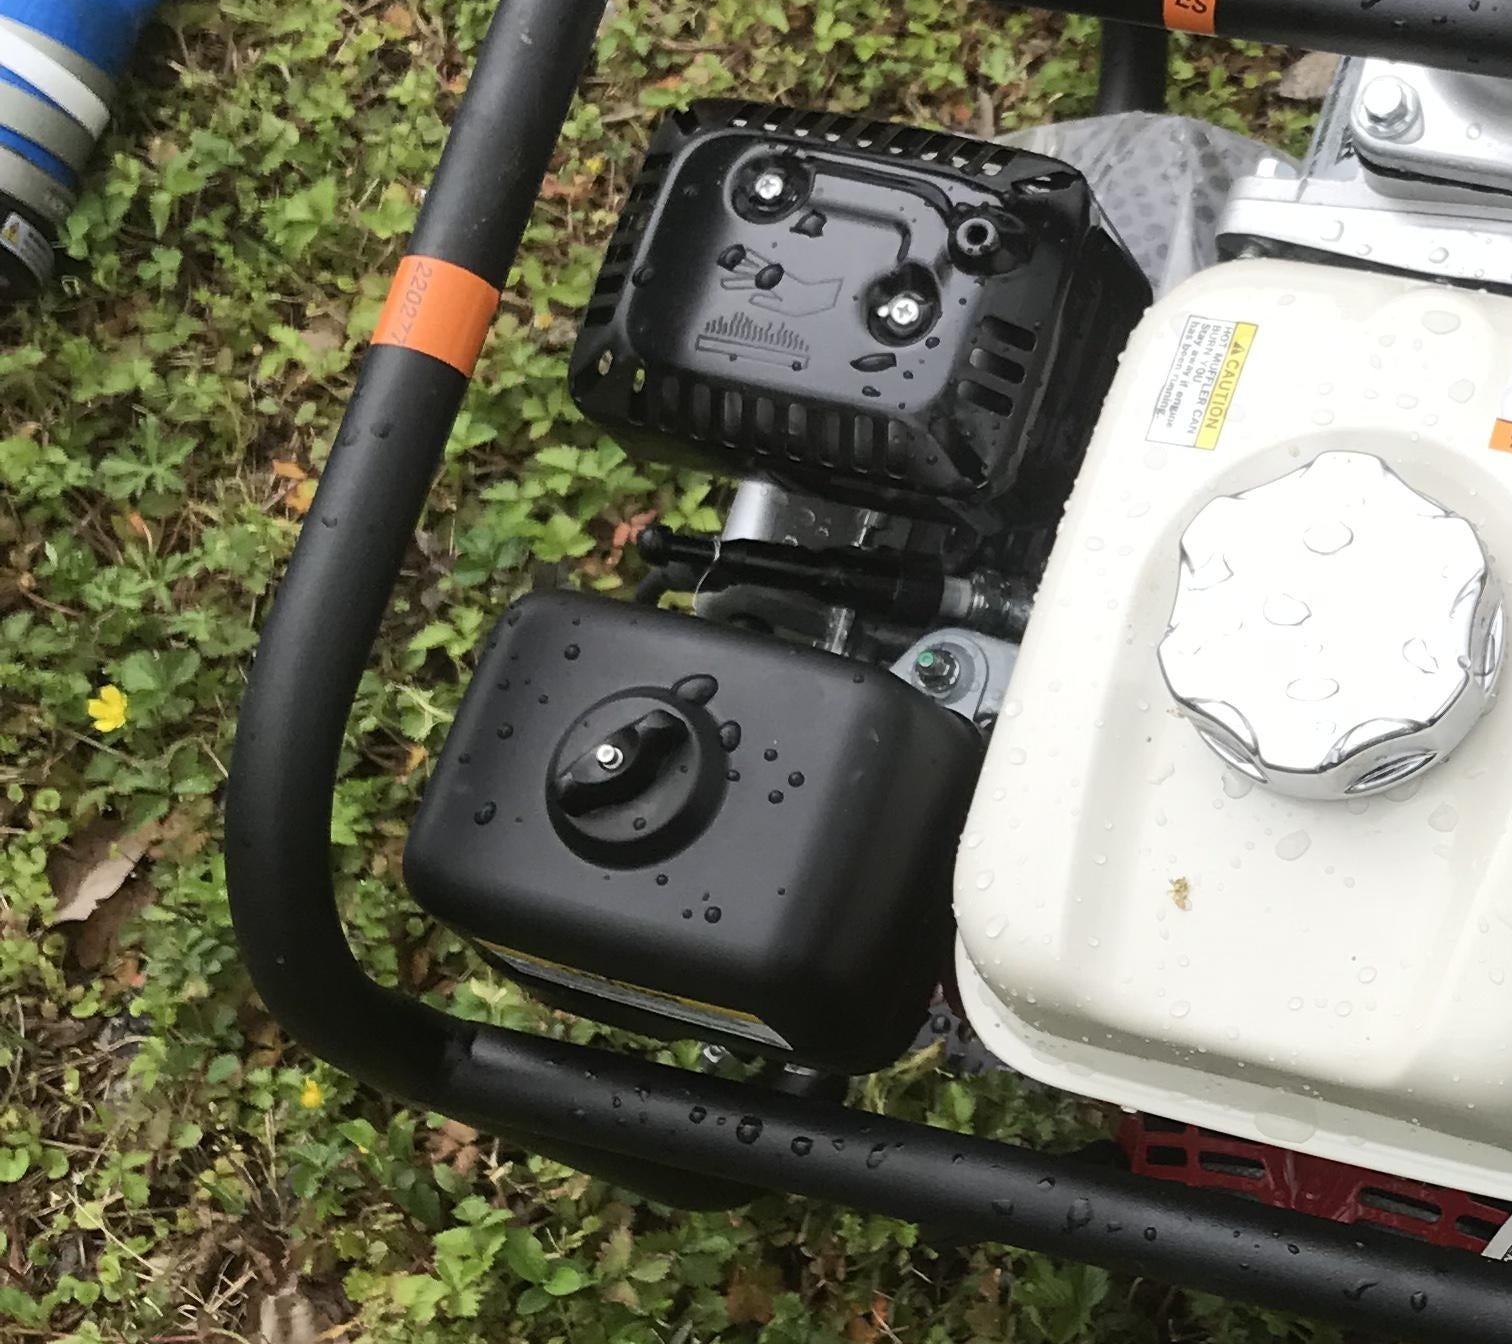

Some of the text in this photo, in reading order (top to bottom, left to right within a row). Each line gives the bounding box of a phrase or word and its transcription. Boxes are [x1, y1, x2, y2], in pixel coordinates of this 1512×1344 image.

[392, 261, 433, 345] 220277
[1186, 321, 1200, 340] has
[1167, 324, 1211, 427] Stay away if engine
[1175, 343, 1191, 370] been
[1187, 327, 1233, 434] HOT MUFFLER CAN
[1193, 325, 1221, 383] BURN YOU
[1205, 359, 1239, 429] CAUTION
